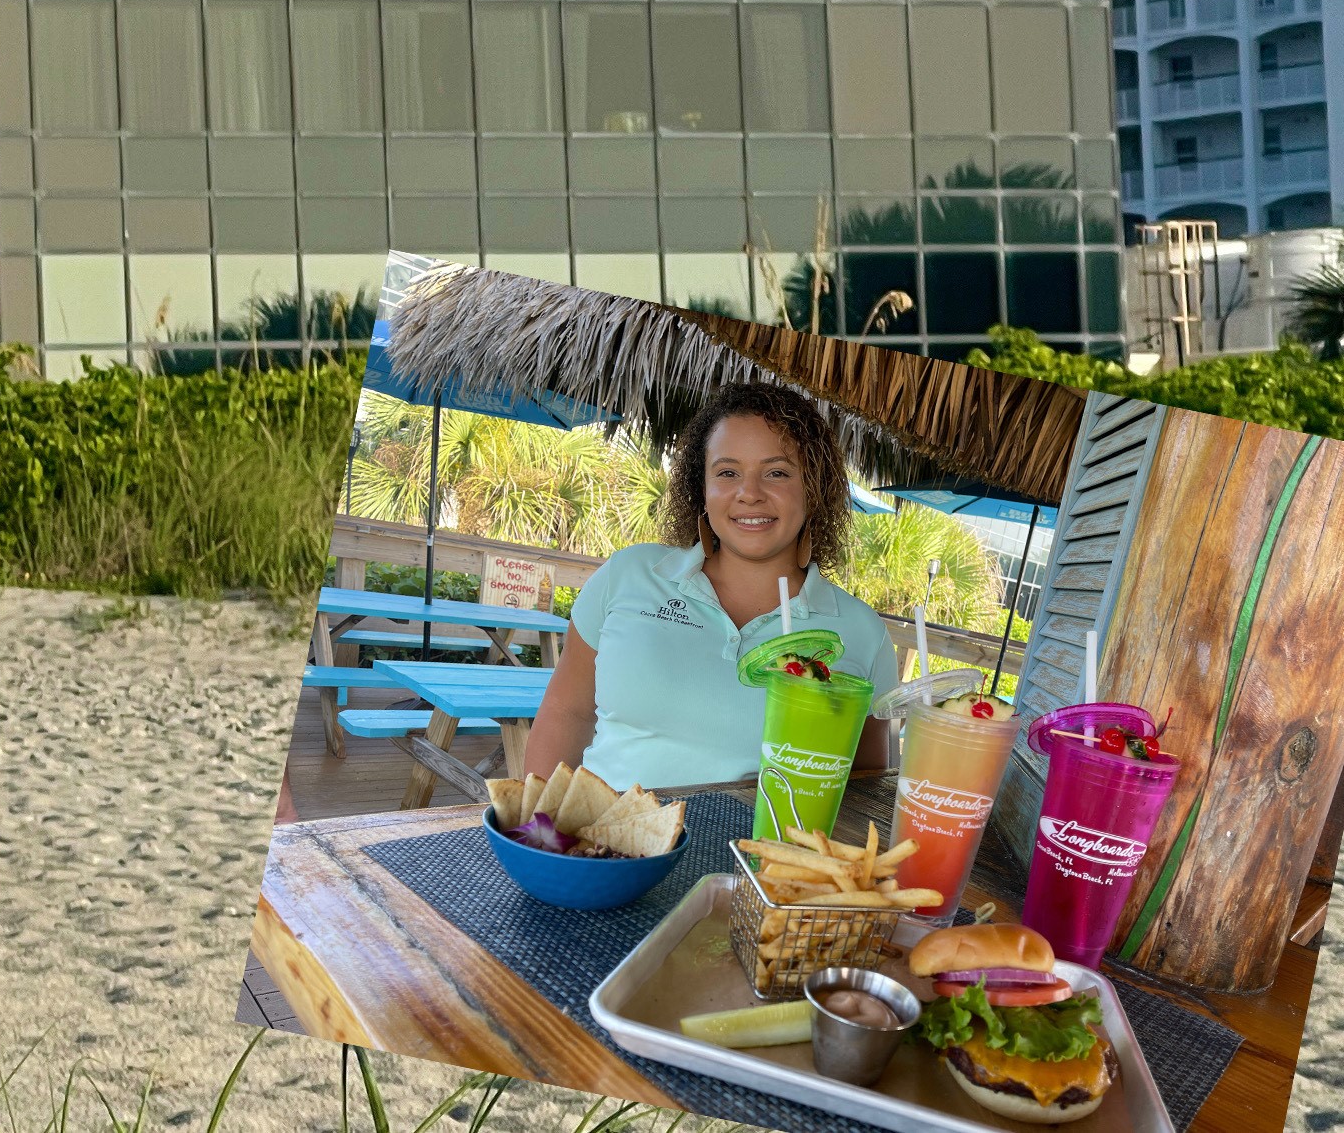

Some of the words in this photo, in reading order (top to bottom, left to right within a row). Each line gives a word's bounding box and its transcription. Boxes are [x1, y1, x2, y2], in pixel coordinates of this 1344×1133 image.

[495, 558, 535, 571] PLEASE
[507, 573, 522, 581] NO
[490, 581, 535, 594] SMOKING
[658, 606, 690, 621] Hilton
[771, 743, 841, 771] Longboards
[908, 780, 982, 810] Longboards
[1052, 820, 1134, 857] Longboards
[1065, 856, 1074, 865] FL
